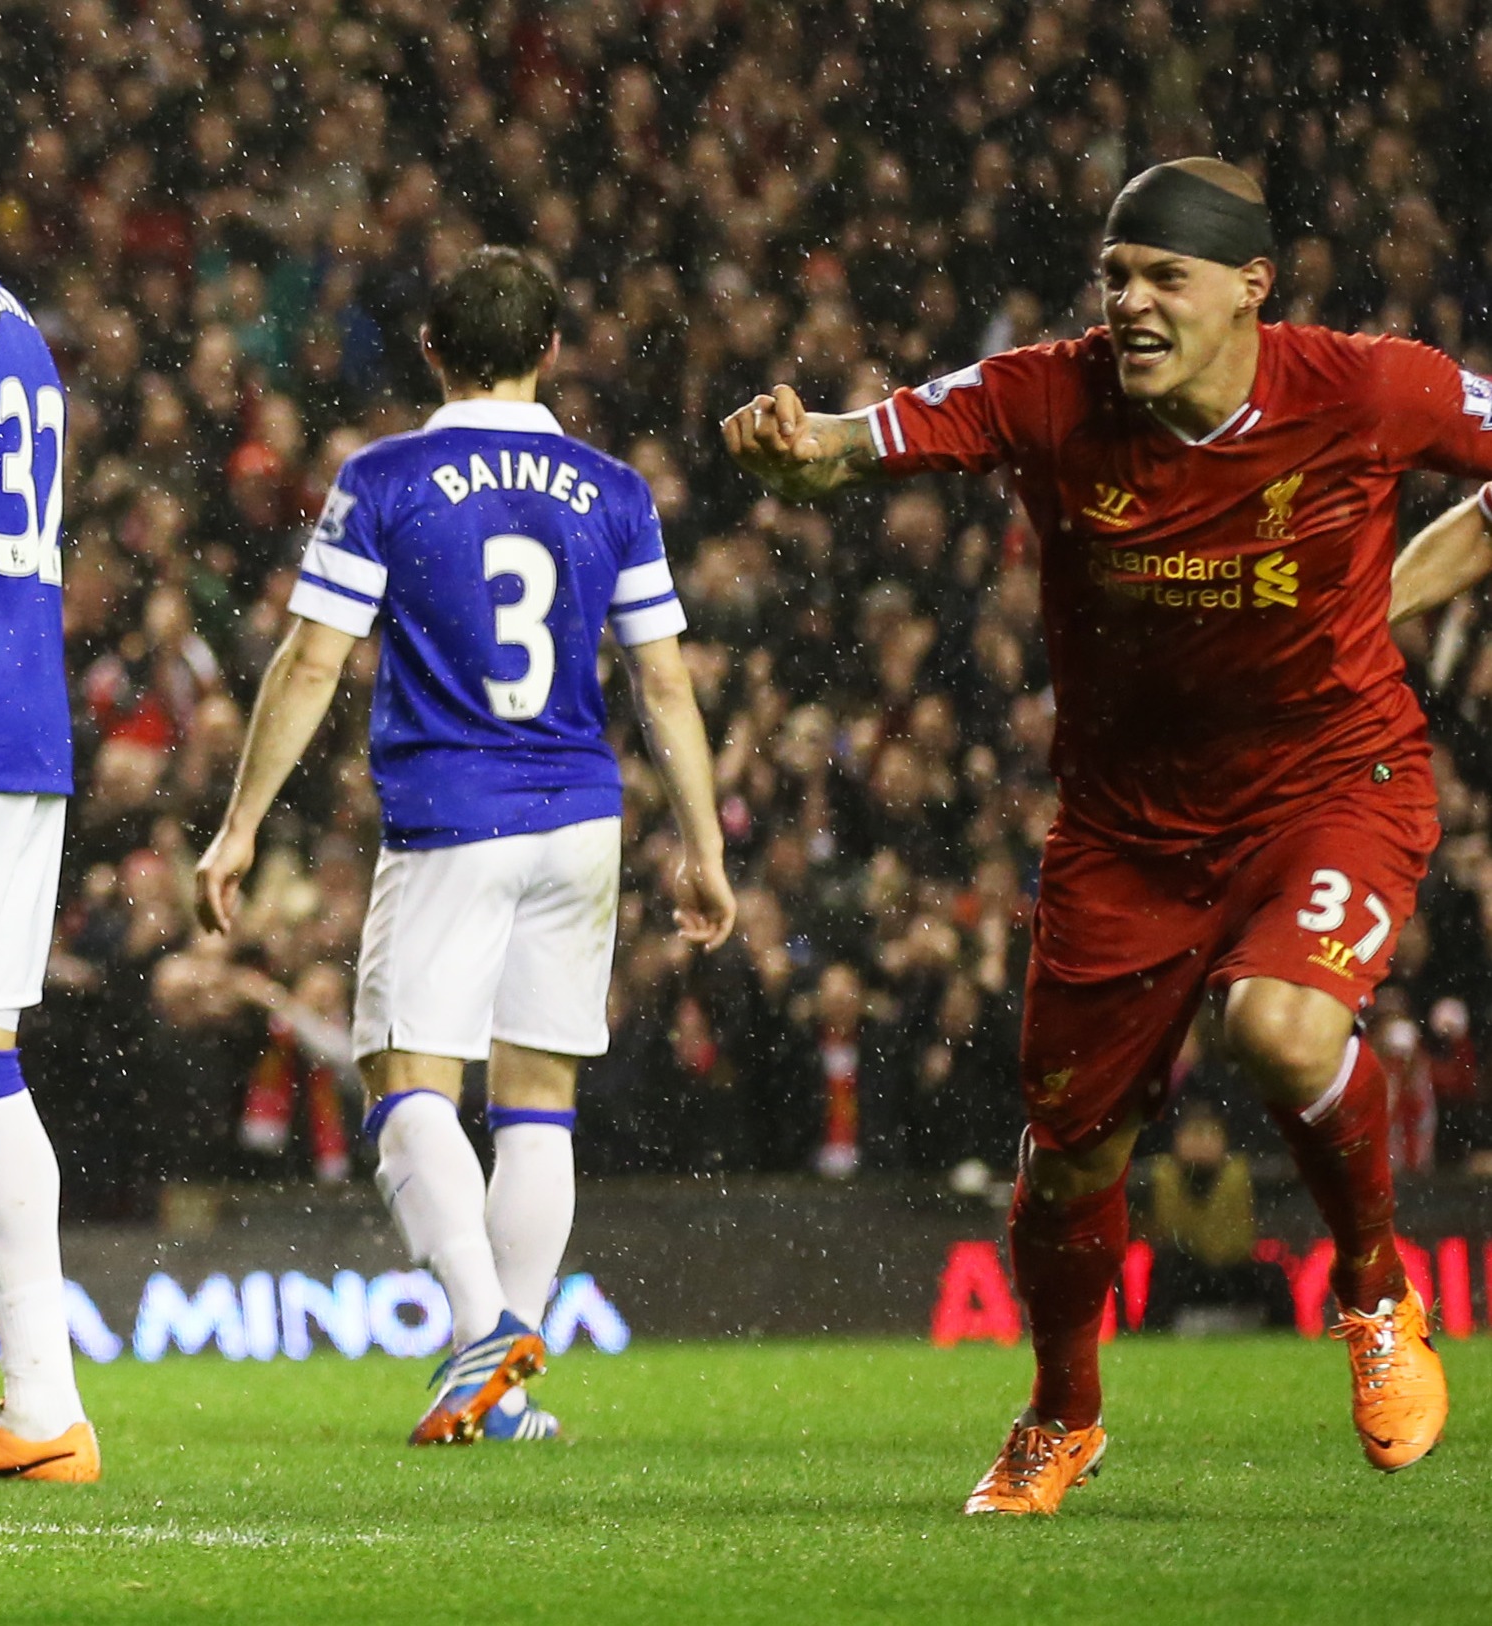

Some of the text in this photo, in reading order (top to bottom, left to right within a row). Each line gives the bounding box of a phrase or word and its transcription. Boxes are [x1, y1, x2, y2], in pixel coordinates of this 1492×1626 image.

[432, 450, 599, 515] BAINES
[481, 534, 558, 722] 3
[1089, 570, 1242, 609] rtered
[1297, 868, 1391, 965] 37
[133, 1269, 631, 1362] MINOA
